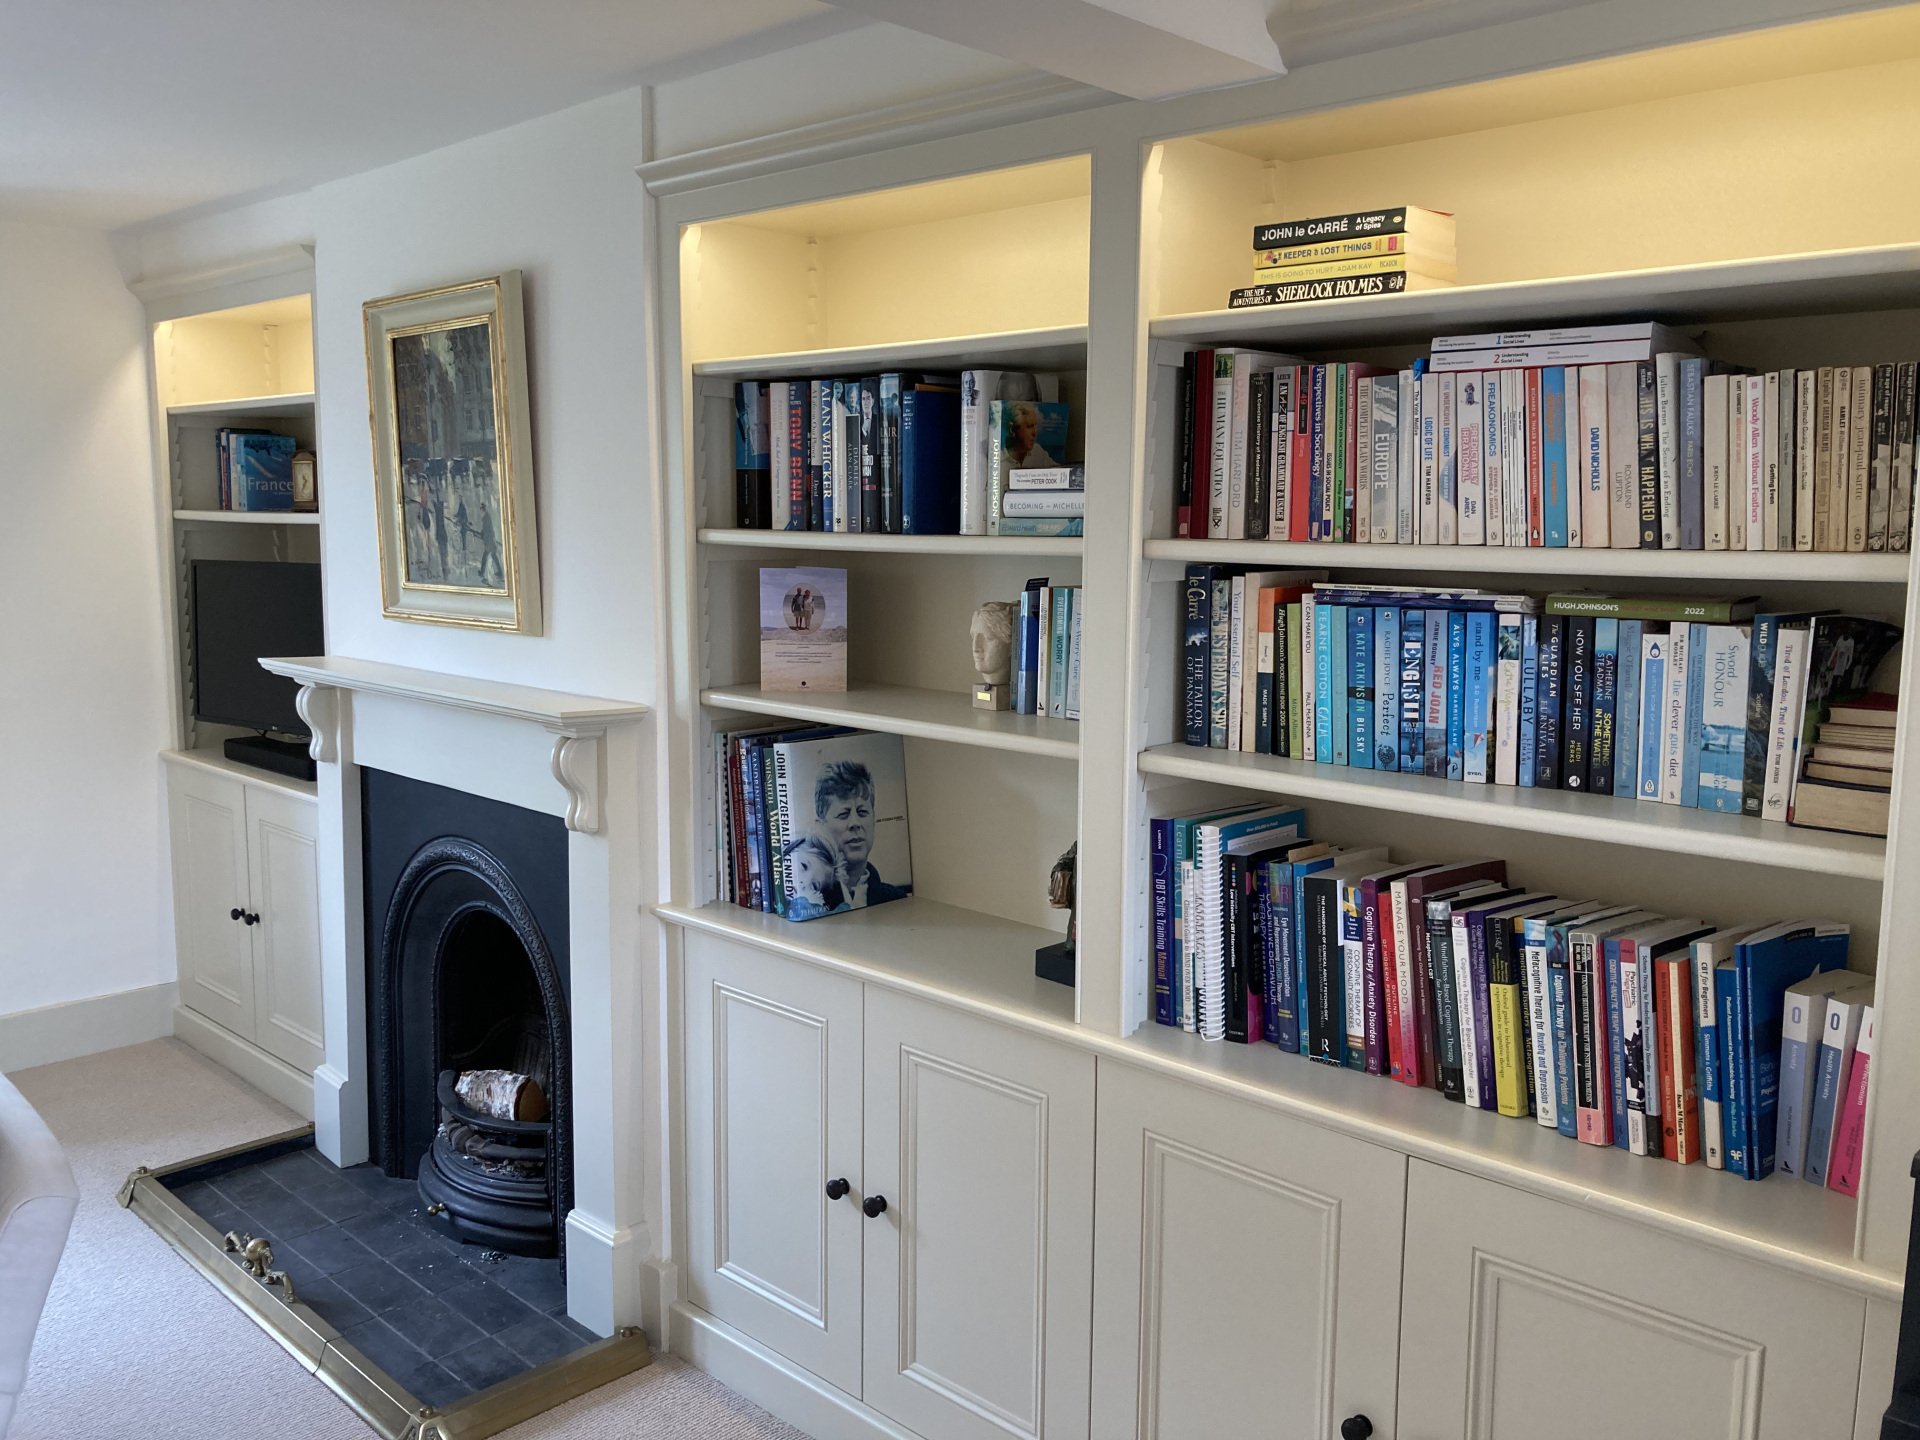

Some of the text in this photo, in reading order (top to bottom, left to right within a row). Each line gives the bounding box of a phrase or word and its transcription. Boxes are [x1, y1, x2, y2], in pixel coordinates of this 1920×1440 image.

[1262, 218, 1348, 240] JOHN le CARRÉ
[1363, 215, 1385, 224] Legacy
[1363, 222, 1381, 230] Spies
[1283, 242, 1372, 260] KEEPER LOST THINGS
[1275, 277, 1382, 302] SHERLOCK HOLMES
[1493, 354, 1500, 363] 2
[1278, 396, 1286, 413] A-Z
[1280, 385, 1287, 395] AN
[1659, 376, 1669, 426] Julian Barnes
[1750, 398, 1759, 425] Woody
[1857, 379, 1867, 420] intimacy
[1278, 425, 1286, 453] ENGLISH
[1279, 414, 1286, 423] OF
[1312, 368, 1324, 477] Perspectives in Sociology
[1359, 384, 1368, 490] THE COMPLETE PLAIN WORDS
[1425, 438, 1432, 446] OF
[1488, 383, 1496, 456] FREAKONOMICS
[790, 407, 802, 501] TONY BENN
[821, 387, 831, 499] ALAN WHICKER
[1213, 397, 1226, 498] HUMAN EQUATION
[1374, 433, 1389, 489] EUROPE
[1461, 428, 1470, 483] IRRATIONAL
[1471, 423, 1479, 485] PREDICTABLY
[1591, 427, 1600, 491] DAVID NICHOLLS
[1854, 426, 1865, 470] jean-paul
[248, 477, 295, 491] France
[1277, 455, 1285, 490] GRAMMAR
[1640, 467, 1655, 521] HAPPENED
[1276, 498, 1284, 519] USAGE
[1751, 487, 1759, 523] Feathers
[1187, 576, 1206, 620] le Carré
[1554, 602, 1619, 611] HUGH JOHNSON'S
[1685, 607, 1705, 615] 2022
[1231, 592, 1241, 679] Your Essential Self
[1472, 650, 1482, 663] by
[1317, 611, 1328, 737] FEARNE COTTON CALM
[1474, 667, 1481, 680] me
[1541, 655, 1549, 678] LIES
[1550, 637, 1558, 697] GUARDIAN
[1596, 653, 1604, 701] STEADMAN
[1605, 654, 1613, 700] CATHERINE
[1713, 652, 1725, 707] HONOUR
[1728, 645, 1739, 678] Sword
[1186, 657, 1194, 726] OF PANAMA
[1194, 656, 1203, 728] THE TAILOR
[1356, 633, 1365, 753] KATE ATKINSON BIG SKY
[1380, 693, 1394, 736] Perfect
[1429, 666, 1444, 724] RED JOAN
[1523, 658, 1534, 725] LULLABY
[1539, 700, 1547, 760] FURNIVALL
[1572, 708, 1581, 730] HER
[1593, 708, 1602, 768] IN THE WATER
[1602, 713, 1611, 766] SOMETHING
[1668, 680, 1682, 777] the clever guts diet
[765, 759, 782, 885] WHSMITH World Atlas
[776, 751, 794, 898] JOHN FITZGERALD KENNEDY
[1155, 879, 1167, 980] DBT Skills Training Manual
[1365, 906, 1374, 942] Cognitive
[1394, 891, 1408, 1004] MANAGE YOUR MOOD
[1353, 950, 1361, 987] COGNITIVE
[1366, 943, 1374, 973] Therapy
[1368, 981, 1376, 1009] Anxiety
[1440, 942, 1454, 1062] Mindfulness-Based Cognitive Therapy
[1700, 962, 1710, 1019] CBT for Beginners
[1355, 1018, 1361, 1027] OF
[1368, 1011, 1377, 1045] Disorders
[1531, 951, 1549, 1104] Metacognitive Therapy for Anxiety and Depression
[1821, 1050, 1835, 1100] Health Anxiety
